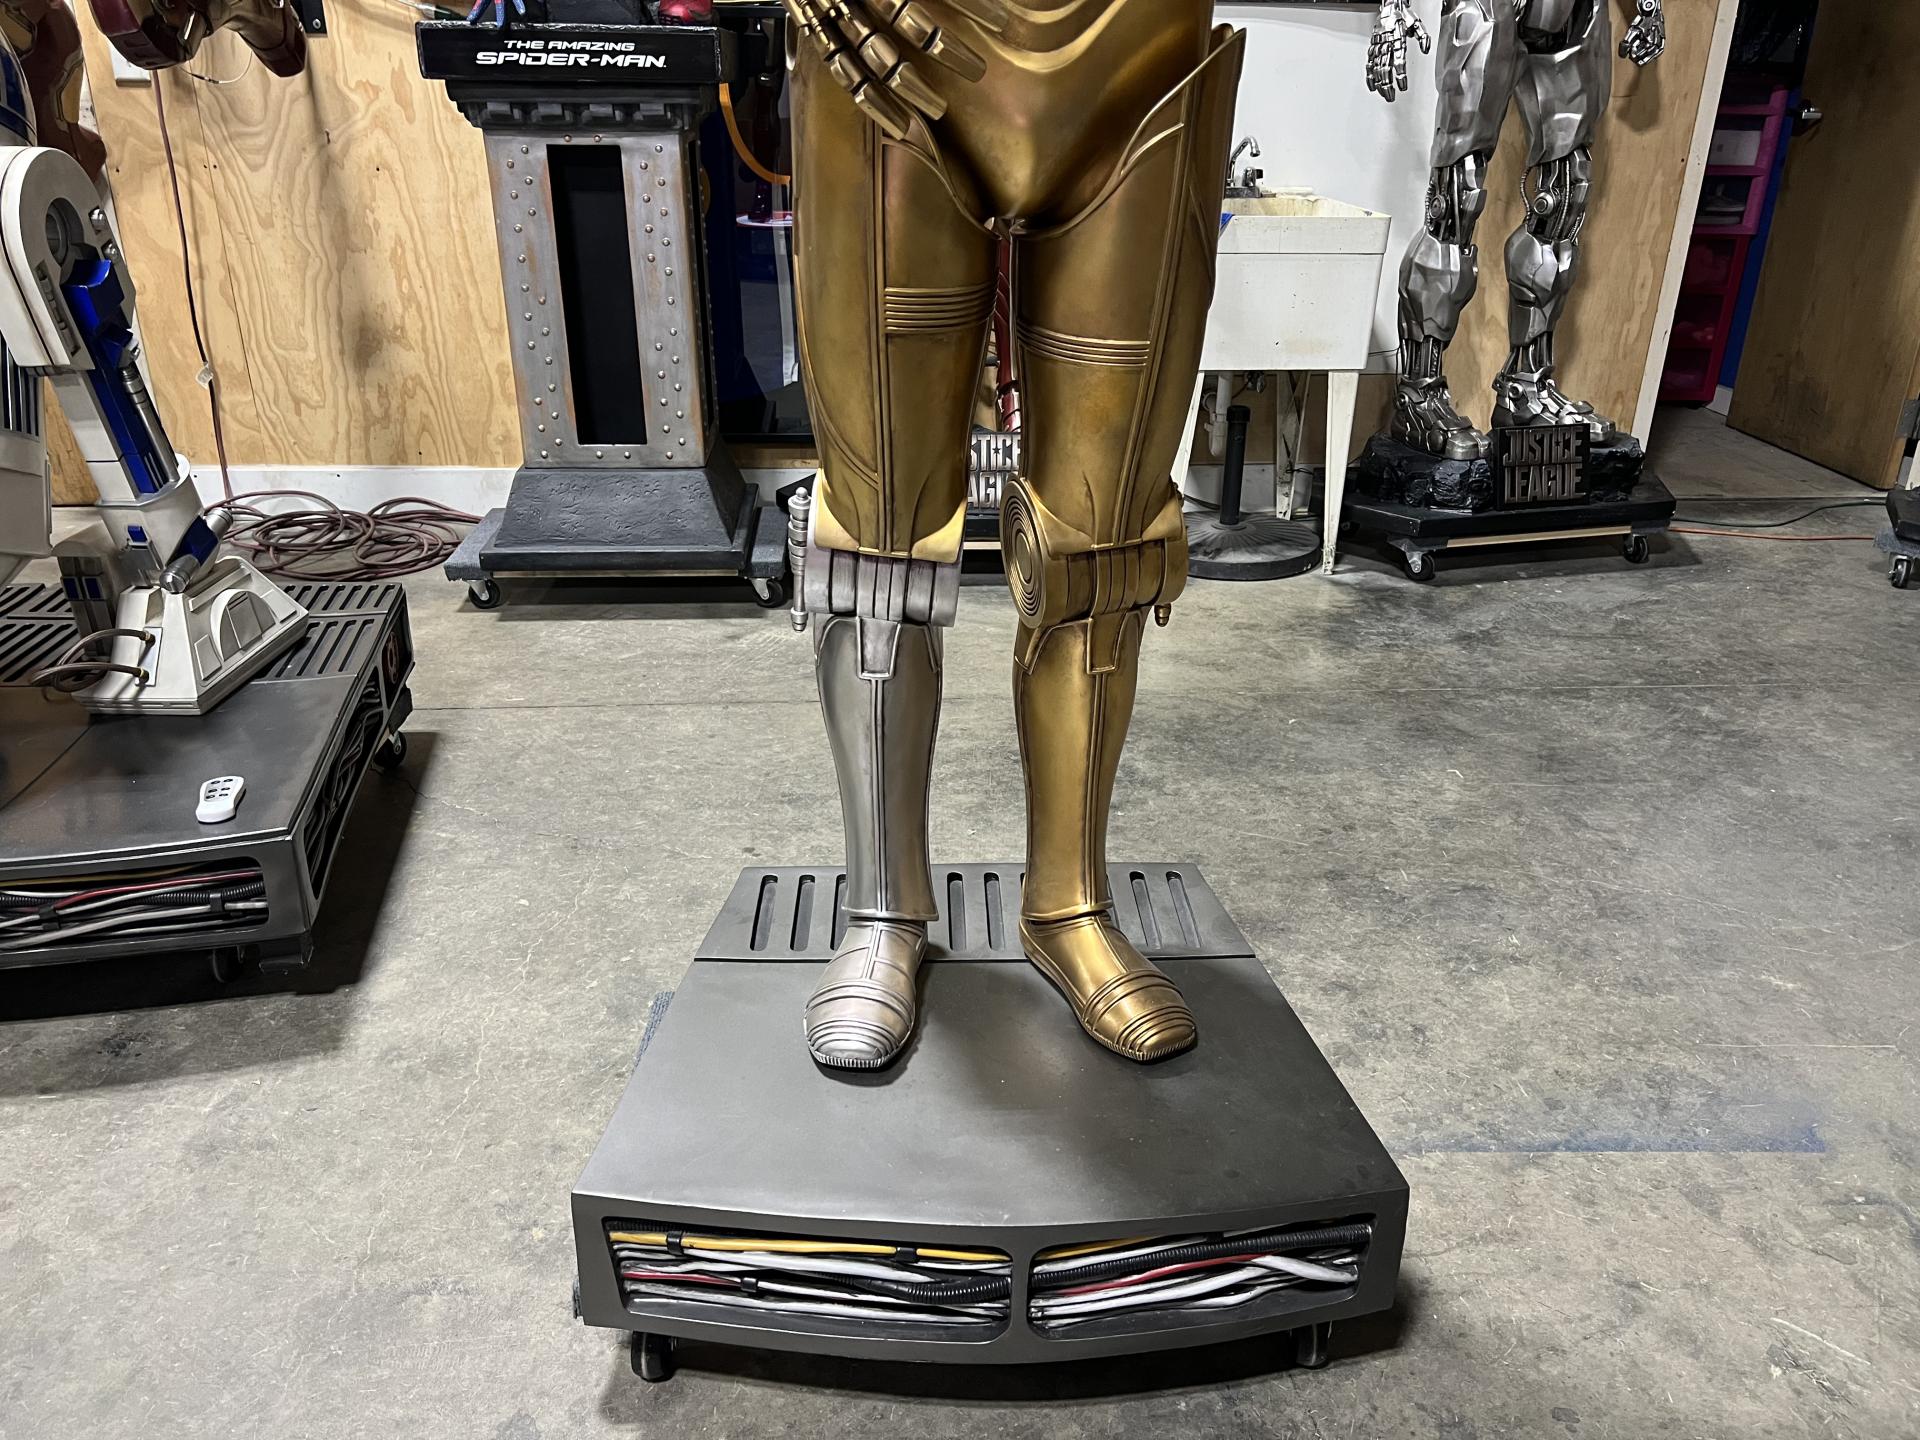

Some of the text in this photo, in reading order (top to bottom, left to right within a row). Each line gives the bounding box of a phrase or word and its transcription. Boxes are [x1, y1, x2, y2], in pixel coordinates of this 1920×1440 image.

[503, 40, 636, 52] THE AMAZING
[1502, 425, 1583, 467] JUSTICE
[1504, 463, 1586, 505] LEAGUE
